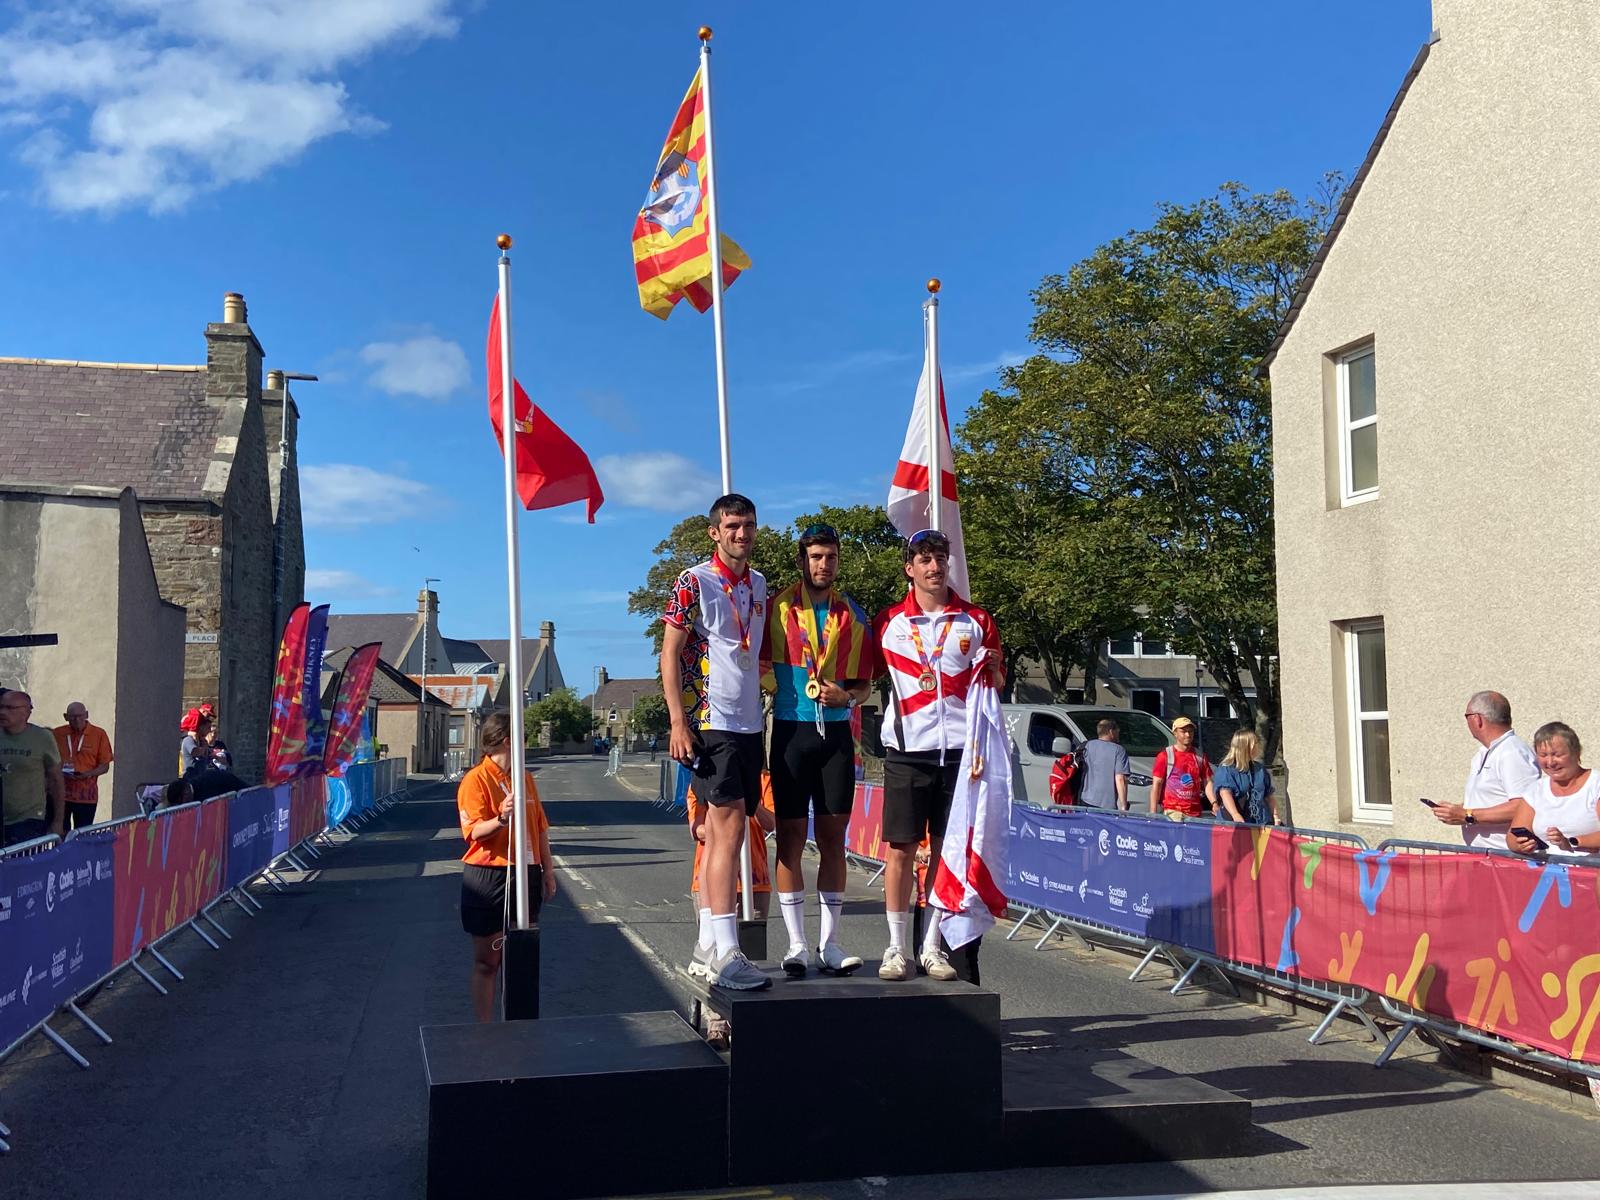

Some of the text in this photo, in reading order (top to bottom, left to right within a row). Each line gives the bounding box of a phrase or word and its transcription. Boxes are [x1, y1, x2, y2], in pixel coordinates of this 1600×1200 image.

[303, 637, 317, 686] ORKNEY
[1116, 834, 1138, 850] Cooke
[1143, 841, 1163, 853] Salmon
[1117, 849, 1138, 858] SCOTLAND
[1182, 845, 1200, 856] Scottish
[1182, 854, 1205, 866] Sea Farms
[1108, 884, 1128, 899] Scottish
[1108, 894, 1124, 908] Water
